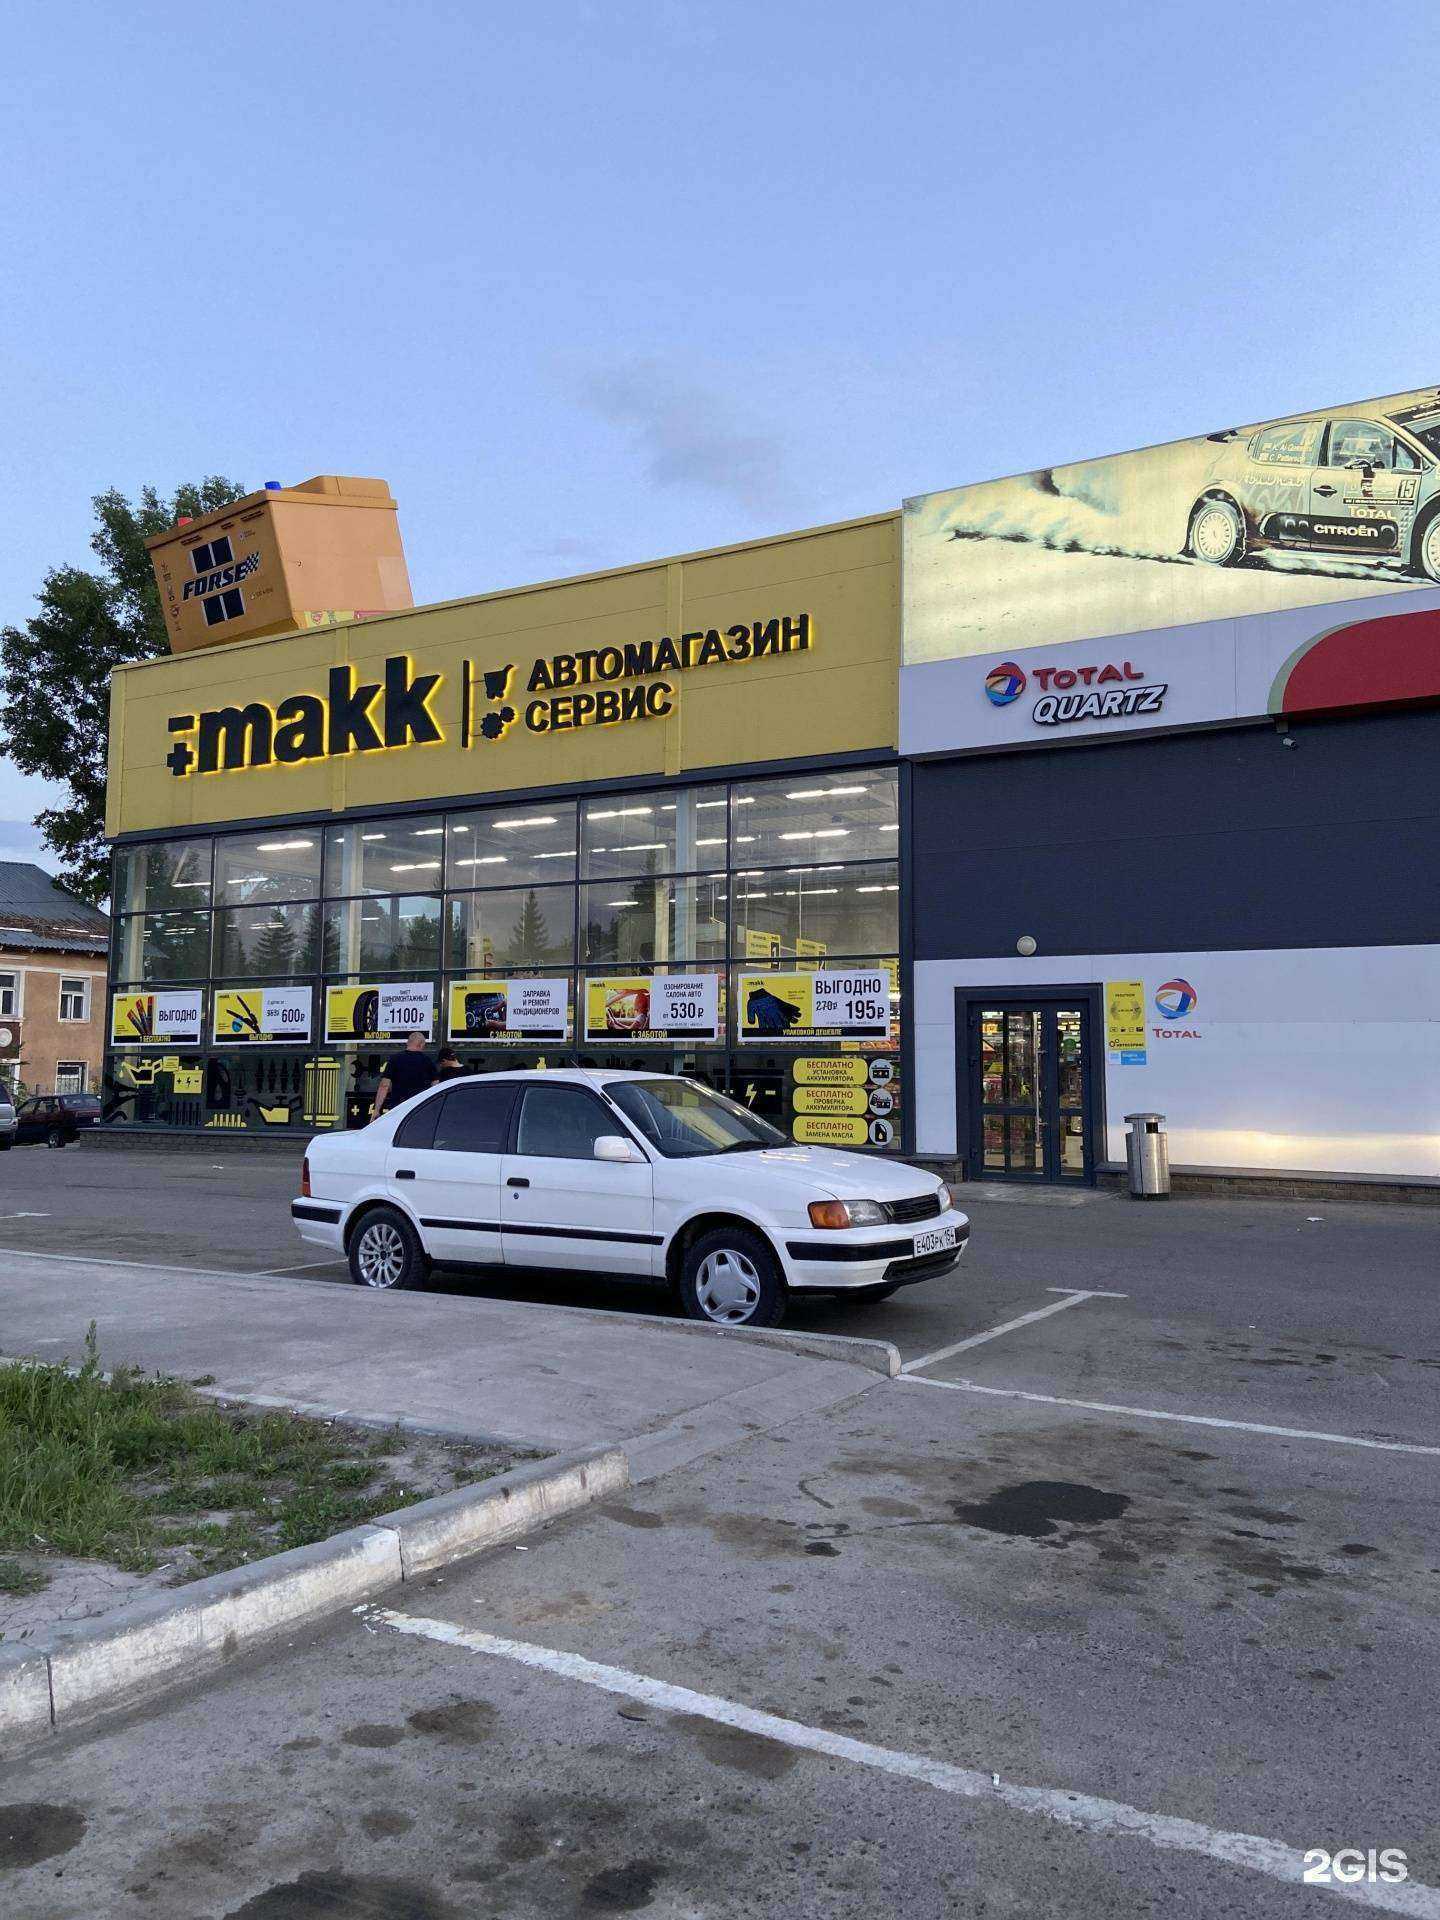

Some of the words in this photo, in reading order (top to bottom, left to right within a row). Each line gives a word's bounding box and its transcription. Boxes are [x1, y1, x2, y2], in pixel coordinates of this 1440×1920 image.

[1348, 505, 1397, 520] TOTAL
[183, 563, 246, 601] FORSE
[527, 613, 810, 692] АВТОМАГАЗИН
[1033, 661, 1144, 690] TOTAL
[525, 682, 673, 733] СЕРВИС
[1033, 684, 1168, 726] QUARTZ
[815, 979, 881, 996] ВЫГОДНО
[522, 990, 551, 998] ЗАПРАВКА
[528, 998, 550, 1007] РЕМОНТ
[158, 1009, 197, 1022] ВЫГОДНО
[513, 1007, 560, 1016] КОНДИЦИОНЕРОВ
[637, 1029, 668, 1039] ЗАБОТОЙ
[1152, 1028, 1202, 1039] TOTAL
[806, 1061, 854, 1069] БЕСПЛАТНО
[806, 1090, 854, 1099] БЕСПЛАТНО
[806, 1121, 854, 1131] БЕСПЛАТНО
[831, 1131, 854, 1139] МАСЛА
